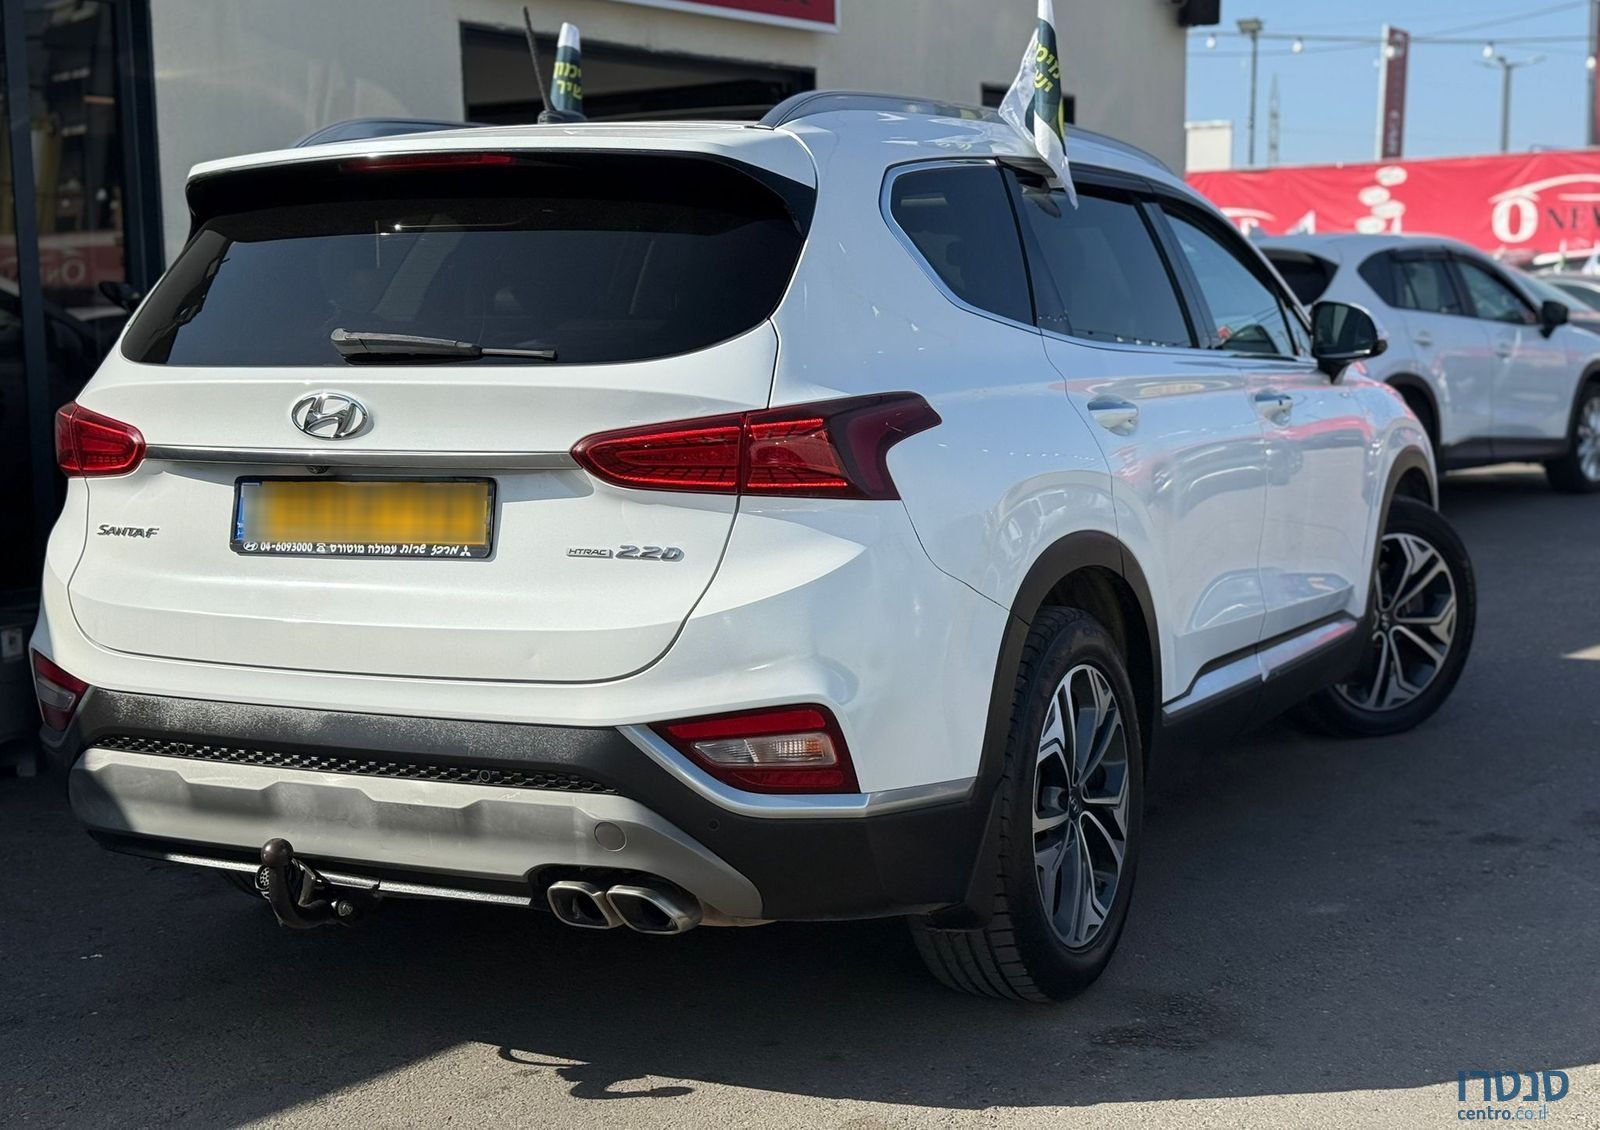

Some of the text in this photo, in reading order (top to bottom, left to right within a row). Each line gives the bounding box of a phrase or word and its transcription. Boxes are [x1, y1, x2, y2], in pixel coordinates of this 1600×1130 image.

[260, 541, 313, 552] 04-6093000
[330, 543, 365, 554] מוטורס
[367, 543, 398, 555] עפולה
[400, 543, 427, 554] שרות
[567, 548, 609, 557] HTRAC
